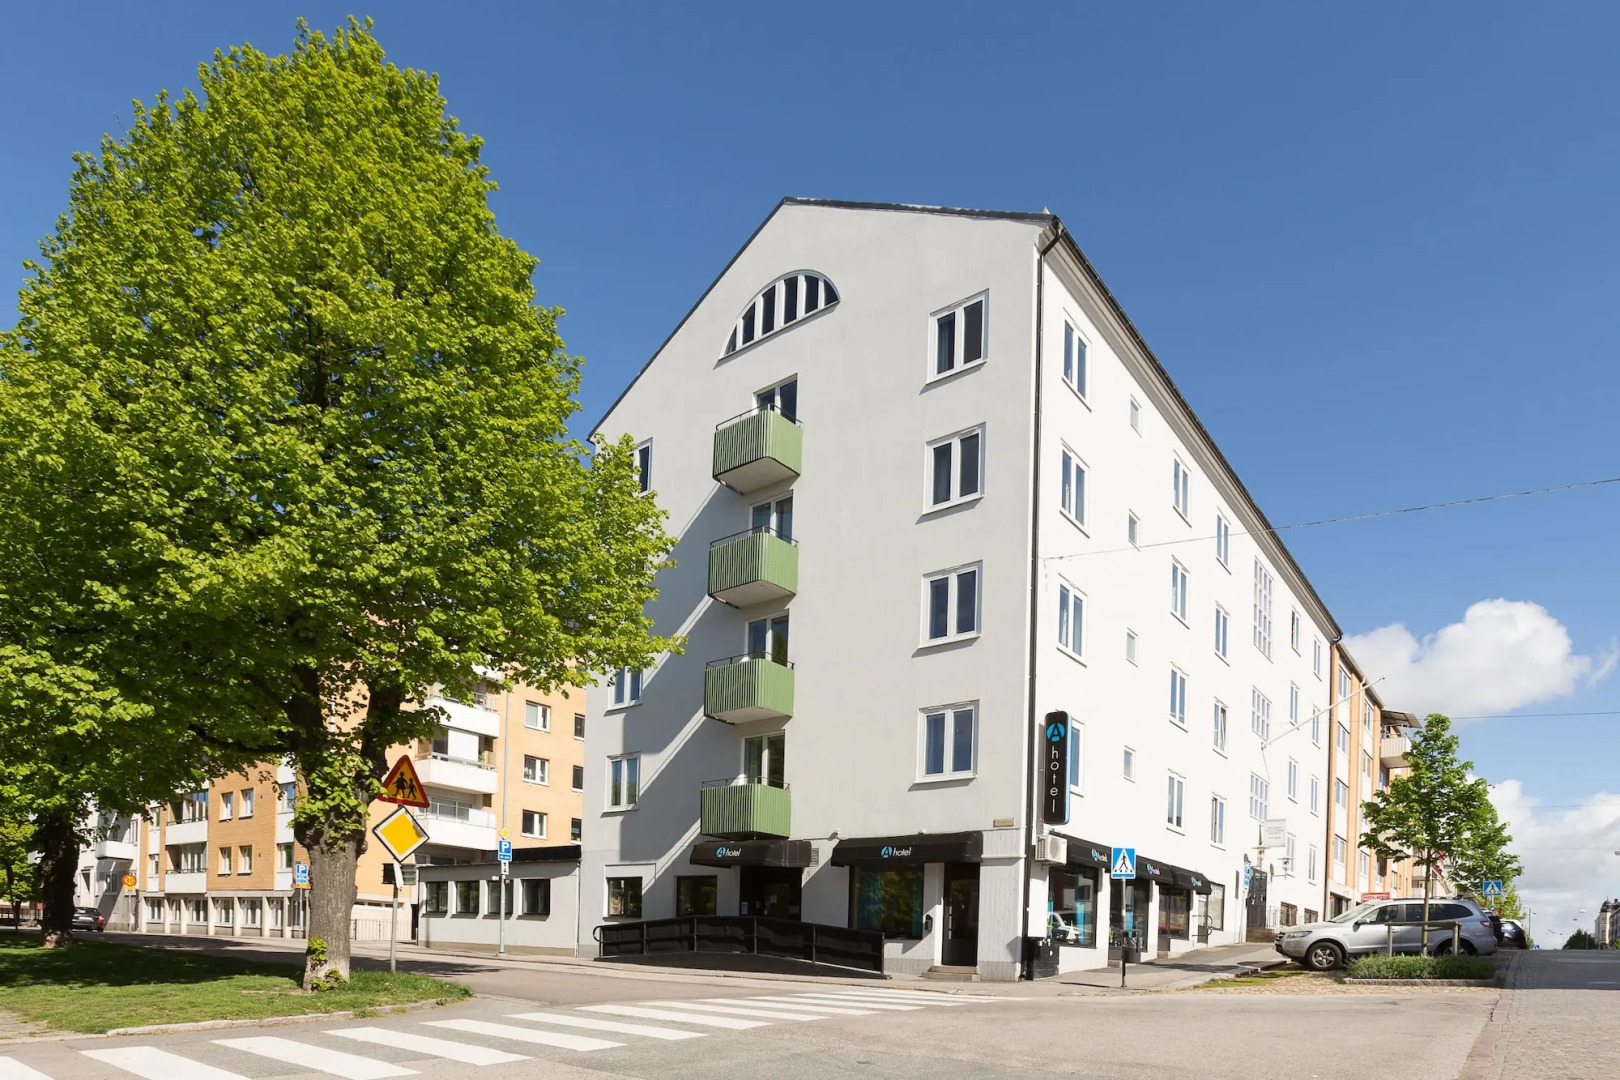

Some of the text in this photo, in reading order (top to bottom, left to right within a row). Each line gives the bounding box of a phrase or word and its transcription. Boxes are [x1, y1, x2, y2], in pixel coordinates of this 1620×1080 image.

[1046, 723, 1065, 813] A hotel
[501, 841, 510, 853] P
[725, 848, 742, 857] hotel
[881, 846, 912, 859] A hotel
